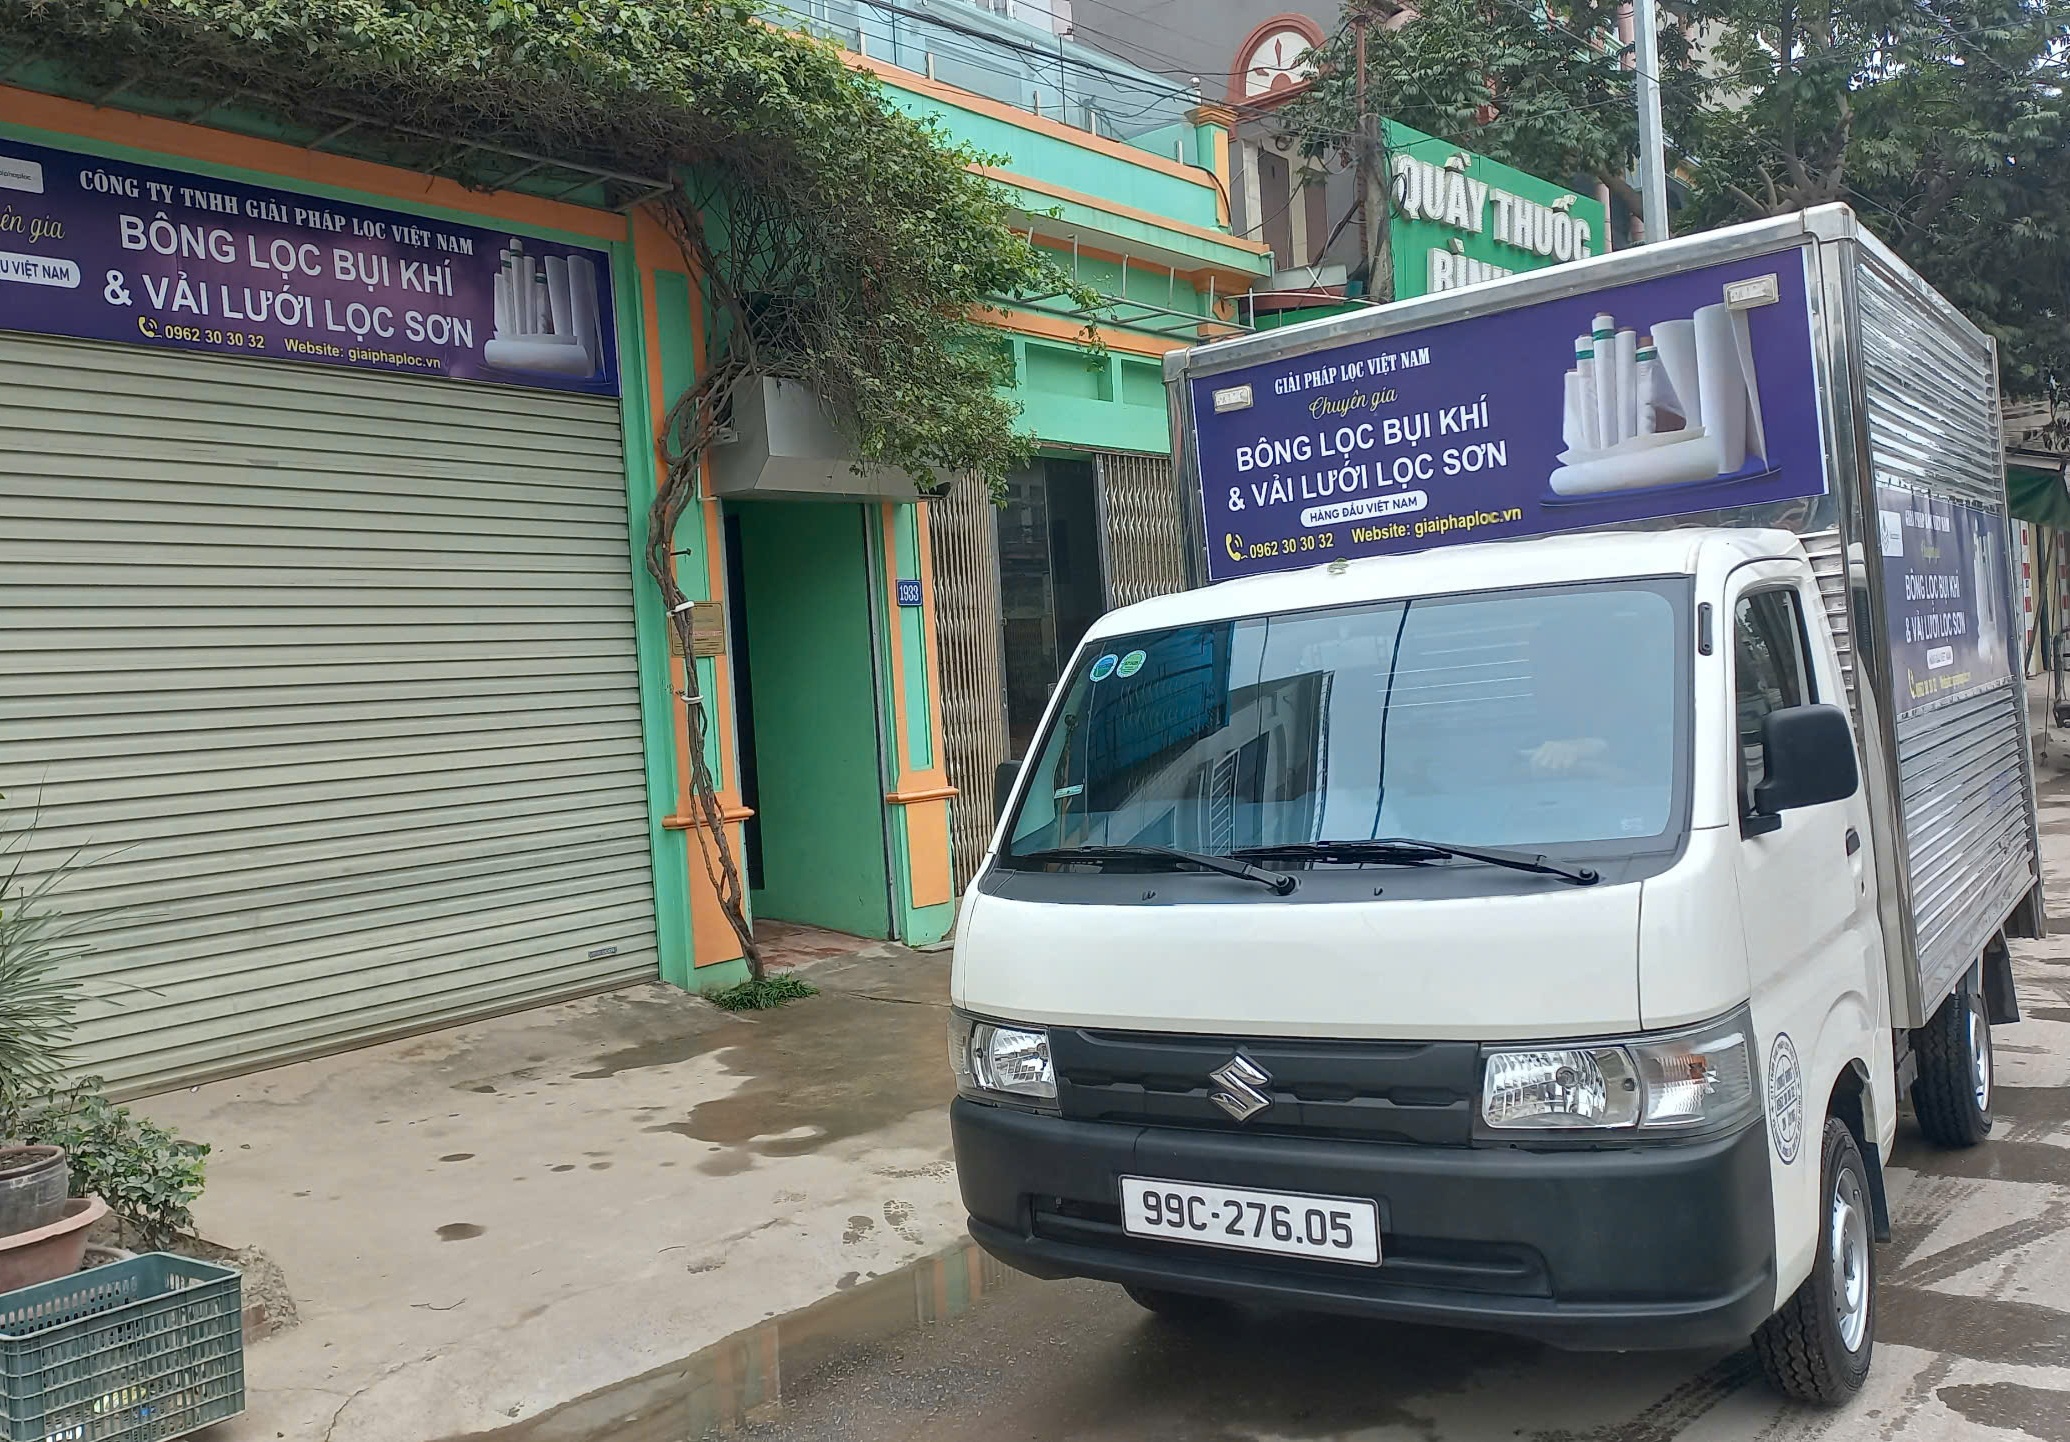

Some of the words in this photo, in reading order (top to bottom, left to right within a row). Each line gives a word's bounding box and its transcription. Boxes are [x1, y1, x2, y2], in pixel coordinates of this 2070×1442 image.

[29, 214, 66, 244] gia
[80, 169, 140, 199] CÔNG
[147, 181, 173, 204] TY
[180, 187, 239, 215] TNHH
[246, 199, 289, 224] GIẢI
[294, 207, 346, 233] PHÁP
[352, 217, 386, 240] LỌC
[391, 224, 431, 248] VIỆT
[436, 233, 474, 256] NAM
[1391, 151, 1488, 233] QUẦY
[1490, 194, 1592, 261] THUỐC
[11, 259, 39, 280] VIỆT
[42, 264, 70, 282] NAM
[119, 211, 236, 264] BÔNG
[248, 234, 322, 280] LỌC
[332, 248, 390, 292] BỤI
[400, 258, 453, 297] KHÍ
[103, 269, 133, 306] &
[142, 271, 209, 316] VẢI
[220, 284, 314, 328] LƯỚI
[325, 299, 395, 342] LỌC
[405, 310, 474, 349] SƠN
[164, 325, 201, 342] 0962
[205, 329, 222, 344] 30
[226, 332, 244, 347] 30
[248, 334, 265, 349] 32
[284, 338, 345, 358] Website:
[348, 347, 442, 370] giaiphaploc.vn
[1274, 371, 1302, 395] GIẢI
[1304, 364, 1337, 389] PHÁP
[1340, 360, 1365, 383] LỌC
[1367, 352, 1397, 376] VIỆT
[1400, 347, 1431, 370] NAM
[1308, 389, 1369, 420] Chuyên
[1369, 386, 1398, 412] gia
[1236, 436, 1313, 472] BÔNG
[1319, 423, 1375, 459] LỌC
[1382, 412, 1431, 447] BỤI
[1438, 393, 1489, 436] KHÍ
[1228, 486, 1246, 512] &
[1250, 473, 1294, 507] VẢI
[1301, 460, 1368, 500] LƯỚI
[1375, 453, 1434, 489] LỌC
[1442, 440, 1507, 476] SƠN
[1249, 541, 1279, 559] 0962
[1281, 538, 1297, 553] 30
[1300, 535, 1316, 551] 30
[1318, 532, 1335, 548] 32
[1352, 523, 1411, 543] Website:
[1415, 507, 1523, 538] giaiphaploc.vn
[1309, 508, 1340, 523] HÀNG
[1365, 500, 1389, 513] VIỆT
[1392, 496, 1418, 509] NAM
[900, 584, 919, 602] 1933
[1143, 1190, 1353, 1249] 99C-276.05
